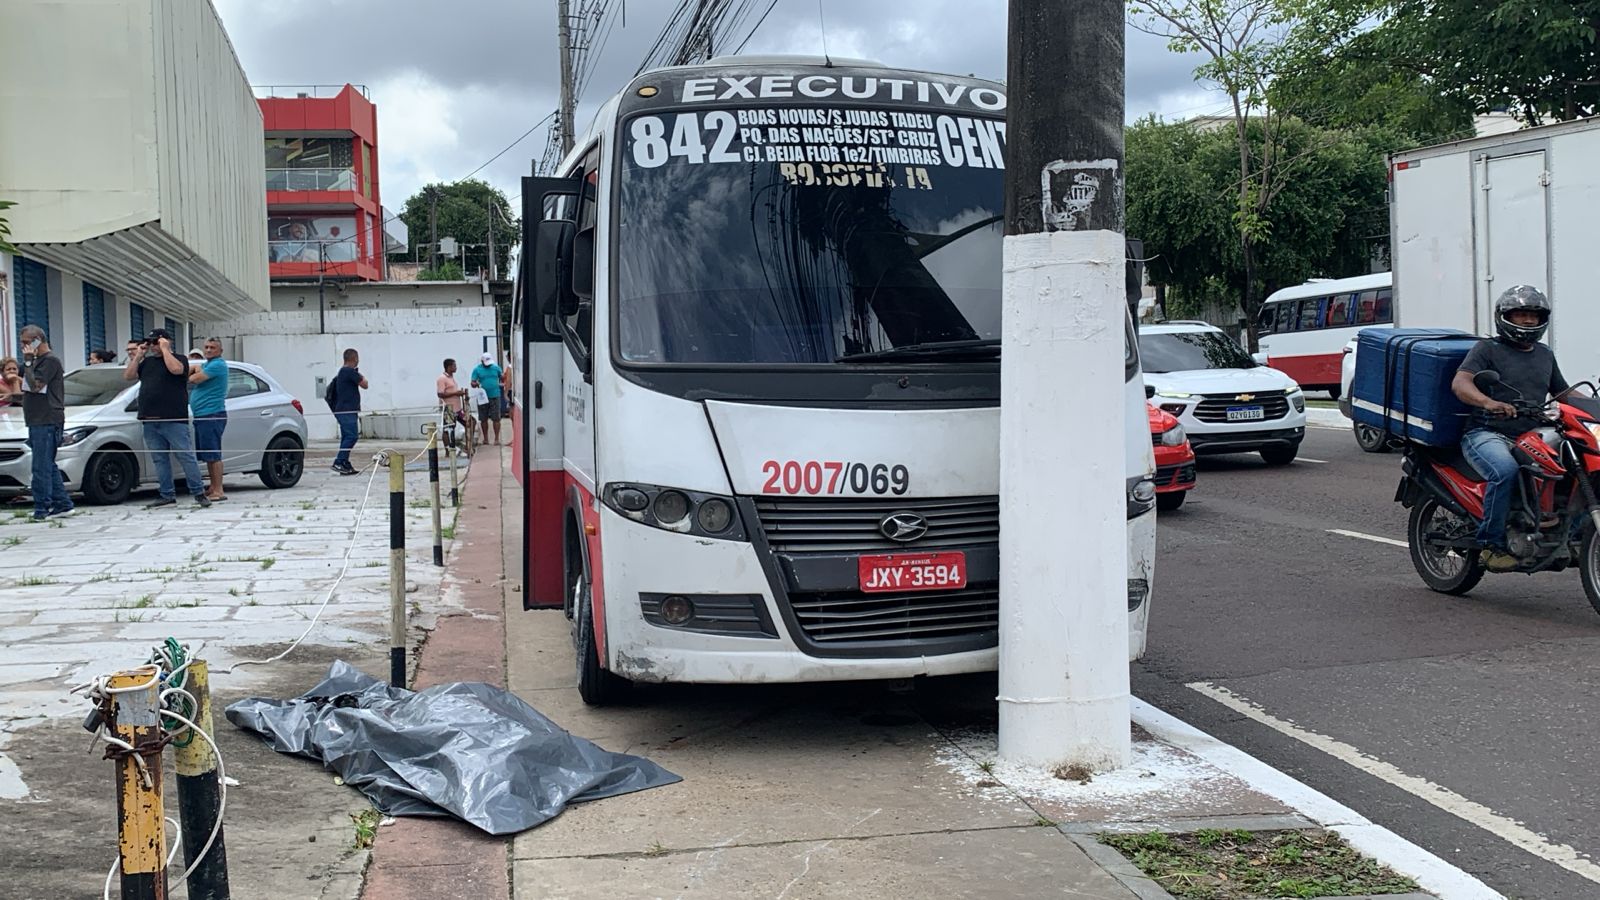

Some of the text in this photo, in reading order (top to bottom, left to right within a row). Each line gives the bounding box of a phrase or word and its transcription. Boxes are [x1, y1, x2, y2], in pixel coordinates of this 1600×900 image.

[682, 76, 1007, 110] EXECUTIVO
[738, 109, 933, 129] BOAS NOVAS/S.JUDAS TADEU
[631, 110, 741, 168] 842
[740, 128, 766, 145] PQ.
[768, 128, 800, 143] DAS
[897, 130, 938, 147] CRUZ
[743, 145, 941, 166] CJ. BEIJA FLOR 1e2/TIMBIRAS
[762, 460, 909, 495] 2007/069
